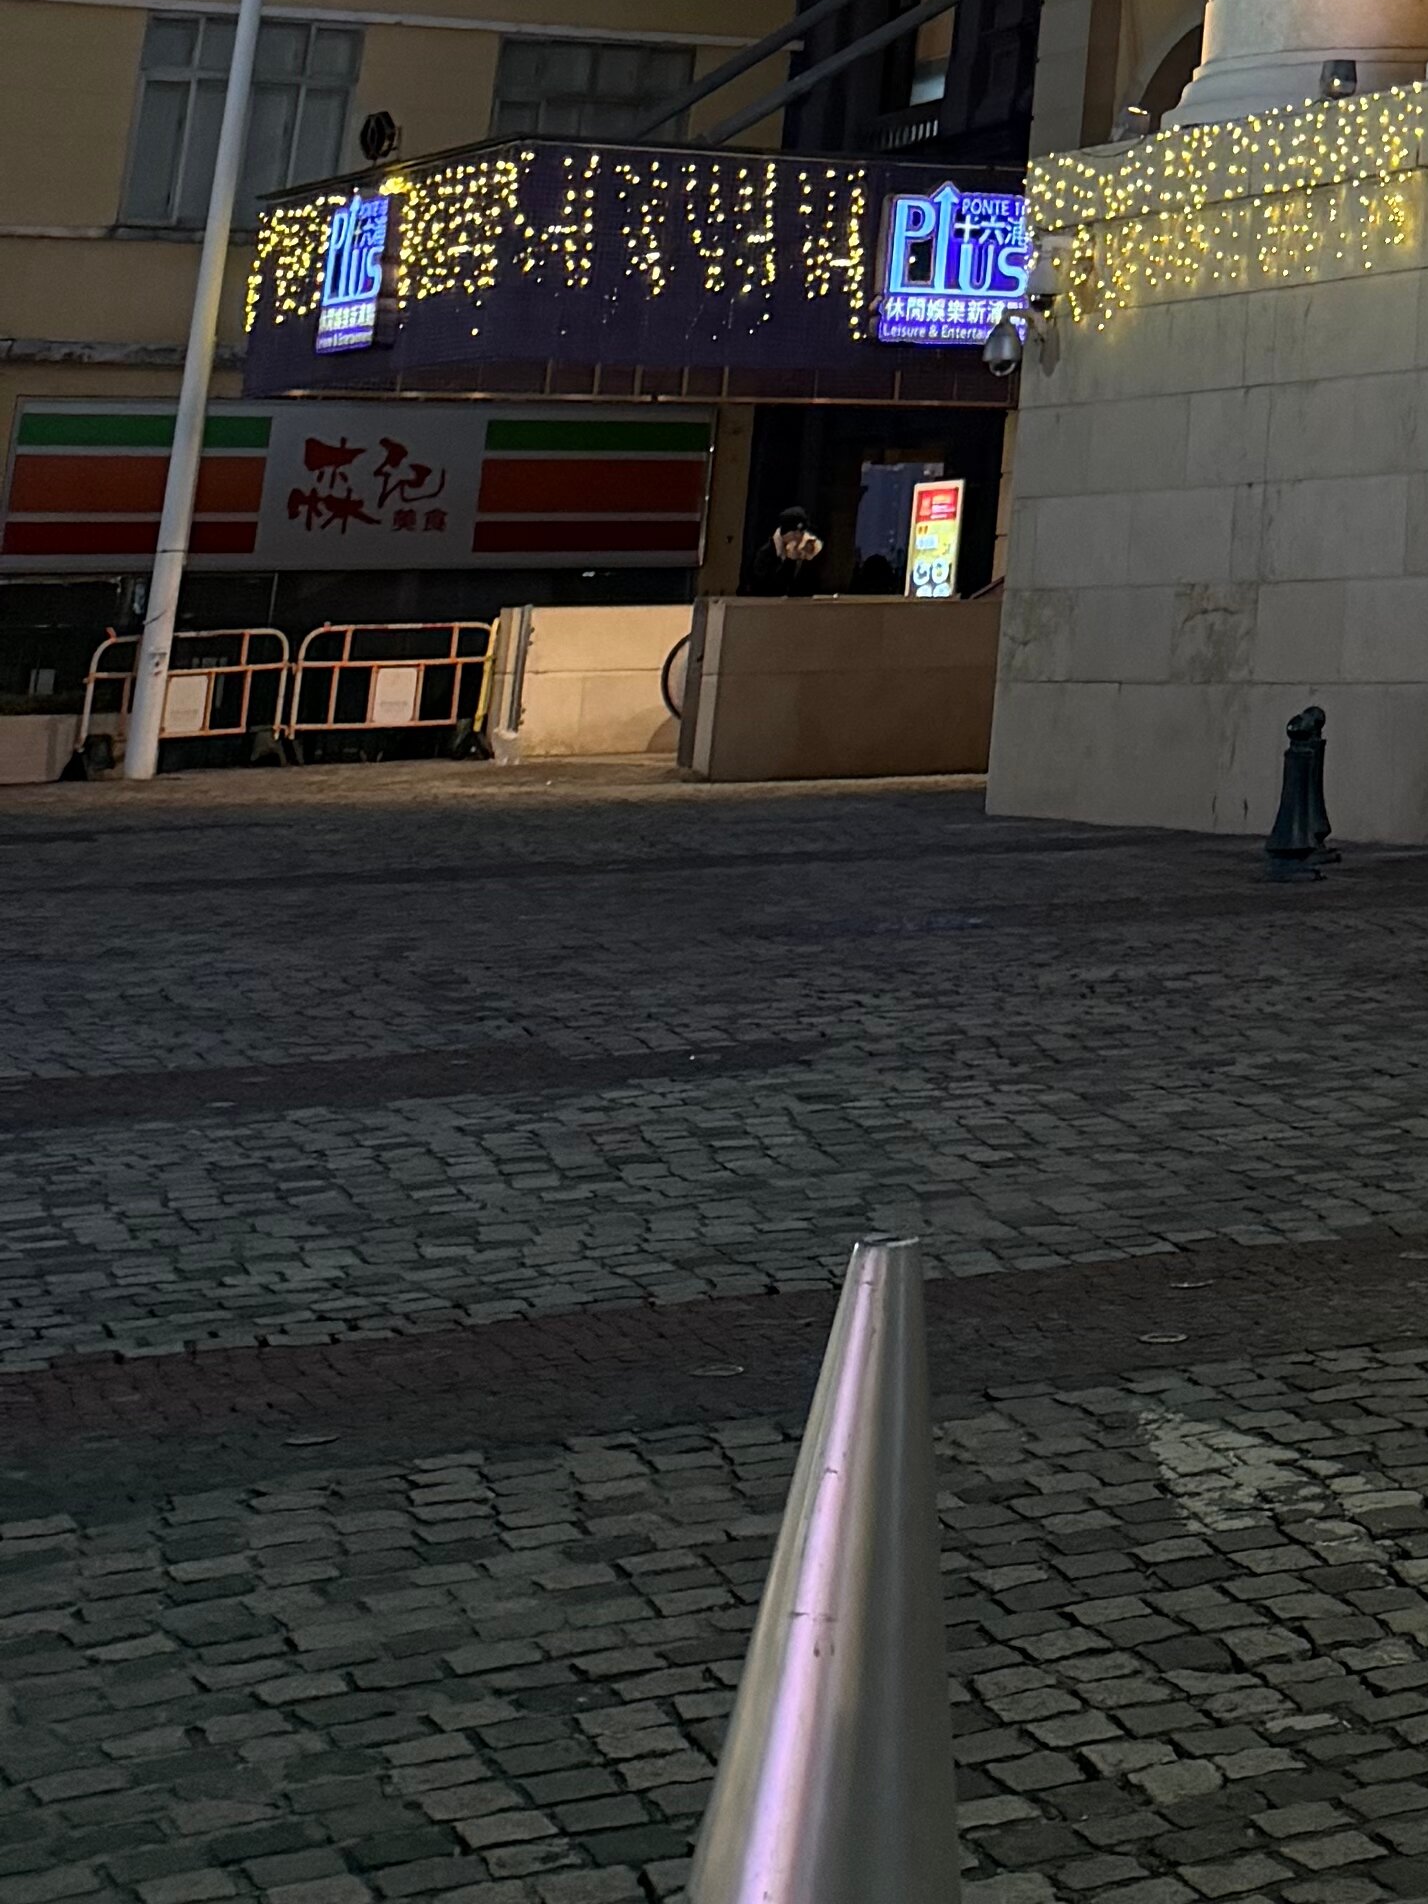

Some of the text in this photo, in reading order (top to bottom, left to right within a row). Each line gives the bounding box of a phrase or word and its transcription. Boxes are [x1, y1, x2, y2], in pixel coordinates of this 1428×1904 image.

[962, 198, 1010, 216] PONTE
[883, 323, 926, 337] Leisure
[929, 324, 938, 338] &
[391, 508, 449, 532] 美食
